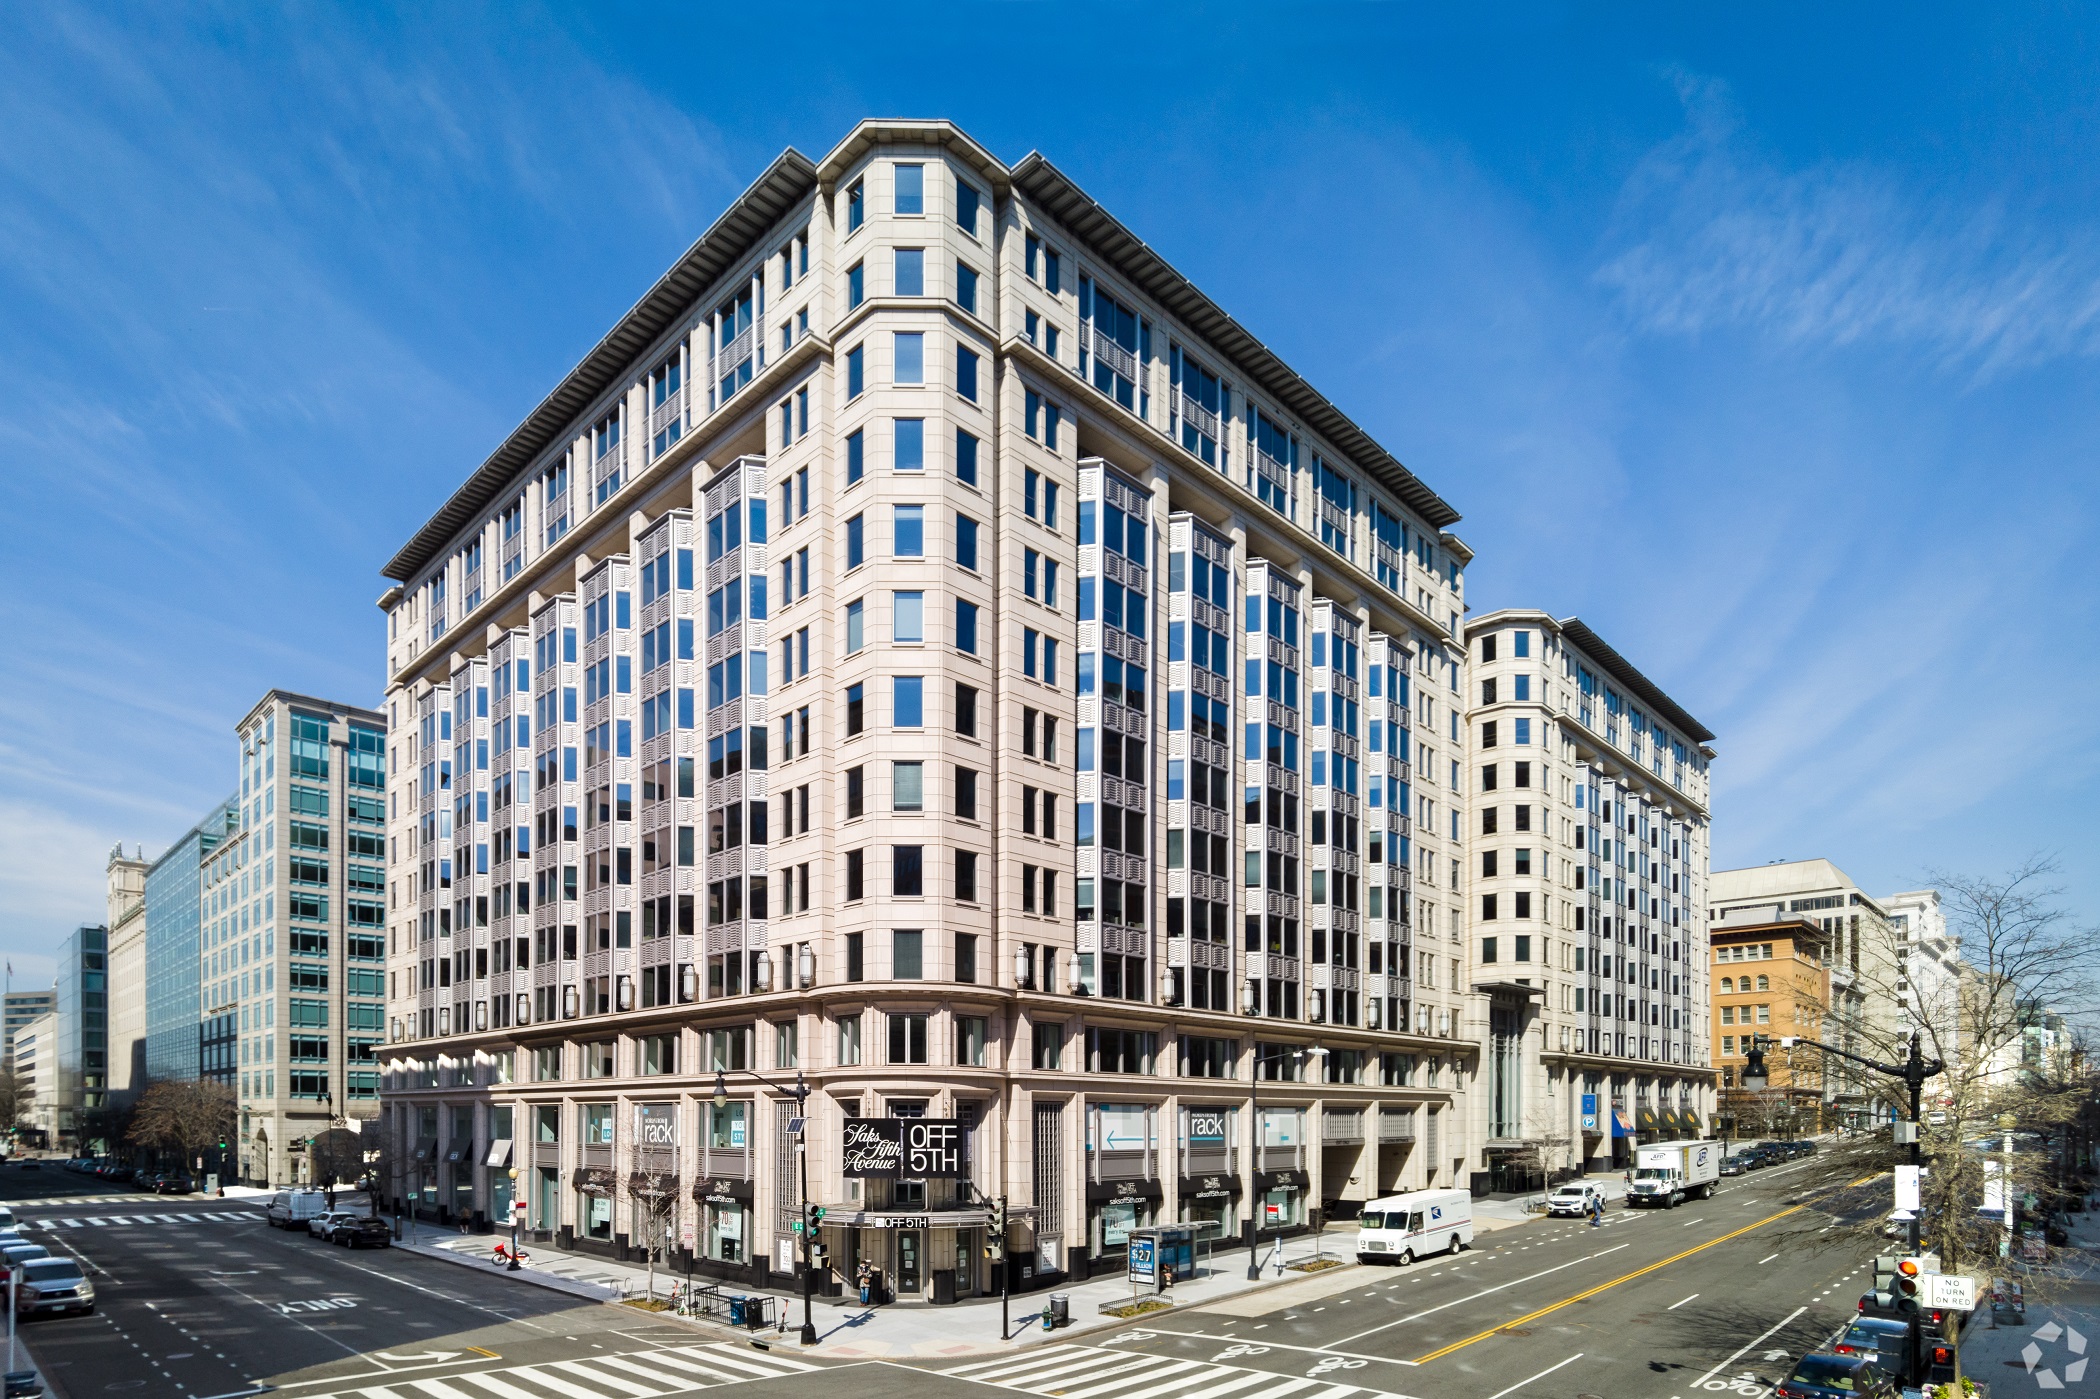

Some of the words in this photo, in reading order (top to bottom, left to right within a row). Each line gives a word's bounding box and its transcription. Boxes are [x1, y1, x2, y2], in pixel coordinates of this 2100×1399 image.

[644, 1118, 673, 1143] rack
[1191, 1113, 1224, 1135] rack
[843, 1123, 880, 1147] Saks
[910, 1125, 957, 1148] OFF
[861, 1139, 901, 1160] Fifth
[910, 1148, 957, 1172] 5TH
[843, 1149, 896, 1172] Avenue
[1109, 1196, 1147, 1205] saksoff5th.com
[884, 1218, 904, 1228] OFF
[906, 1218, 927, 1228] 5TH
[1941, 1288, 1965, 1296] TURN
[1952, 1298, 1971, 1306] RED
[276, 1298, 358, 1313] ONLY
